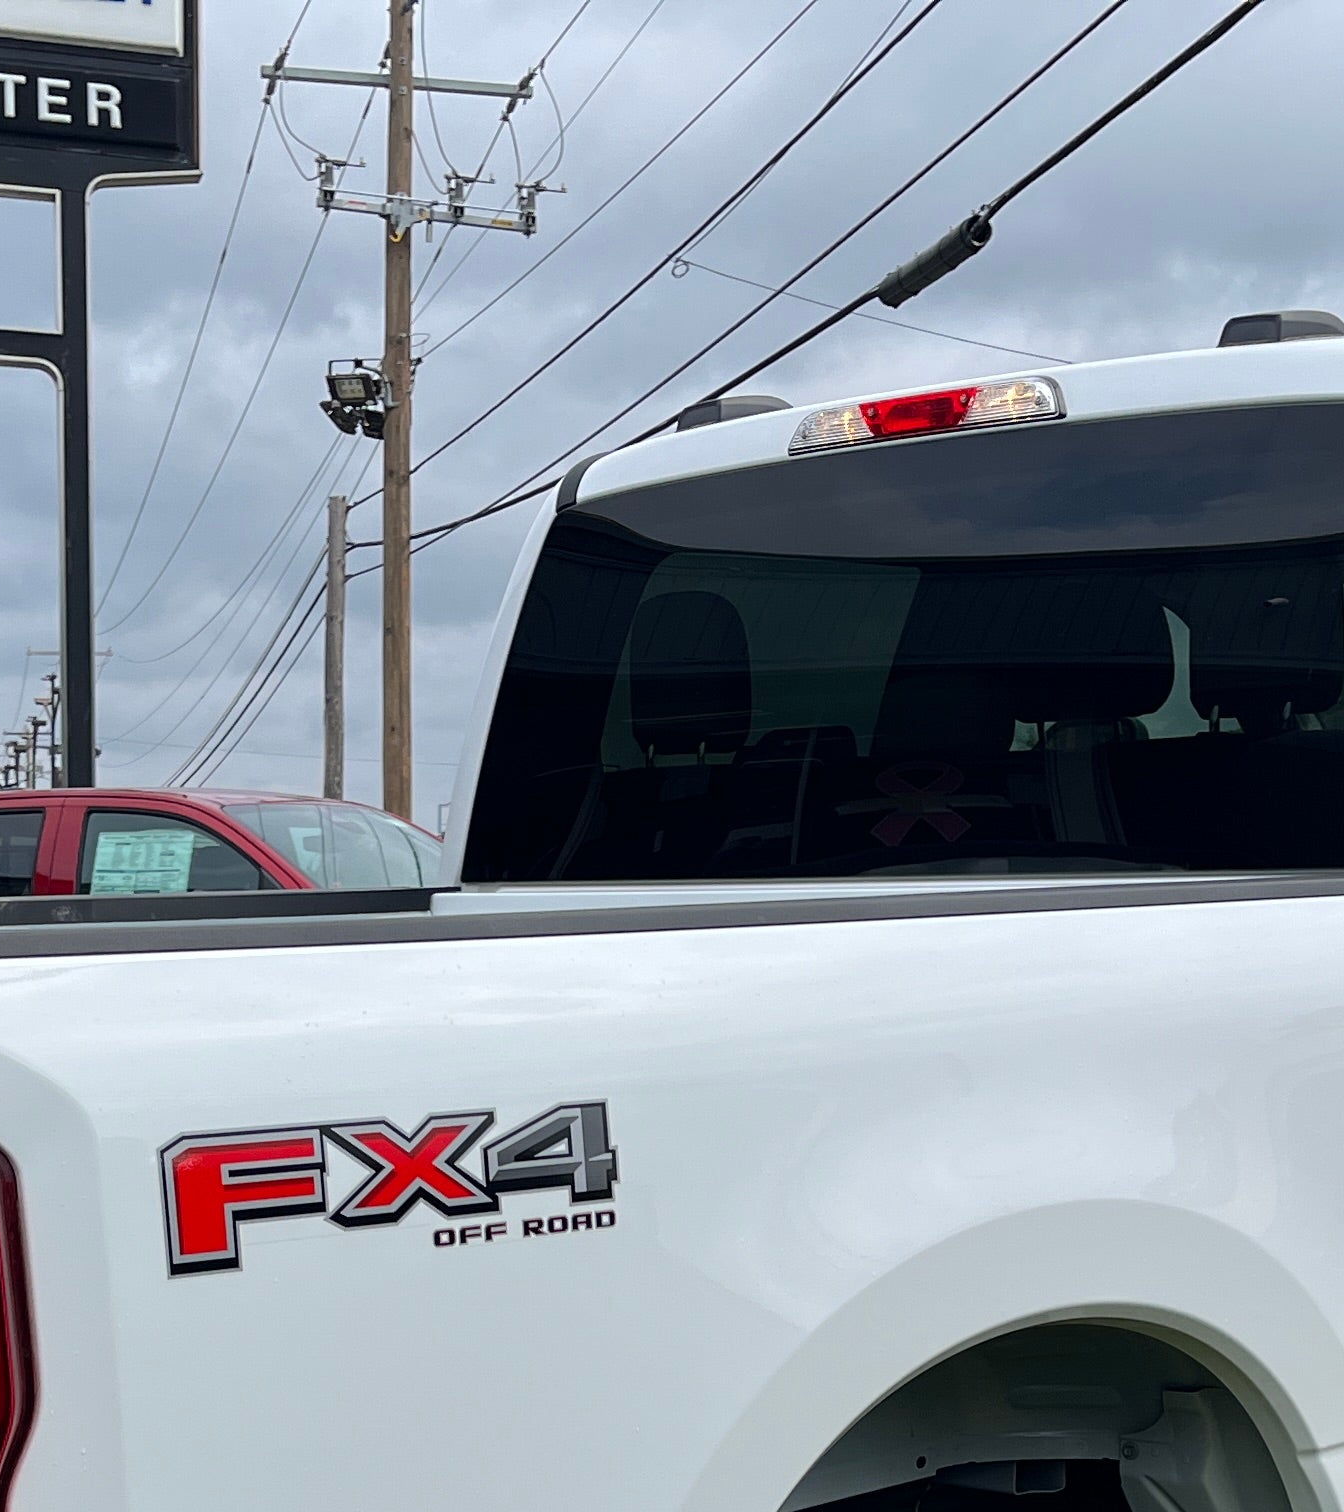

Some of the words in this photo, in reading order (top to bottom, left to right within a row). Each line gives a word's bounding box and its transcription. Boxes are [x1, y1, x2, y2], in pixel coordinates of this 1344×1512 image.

[157, 1098, 621, 1280] FX4
[432, 1221, 508, 1249] OFF
[522, 1208, 618, 1240] ROAD
